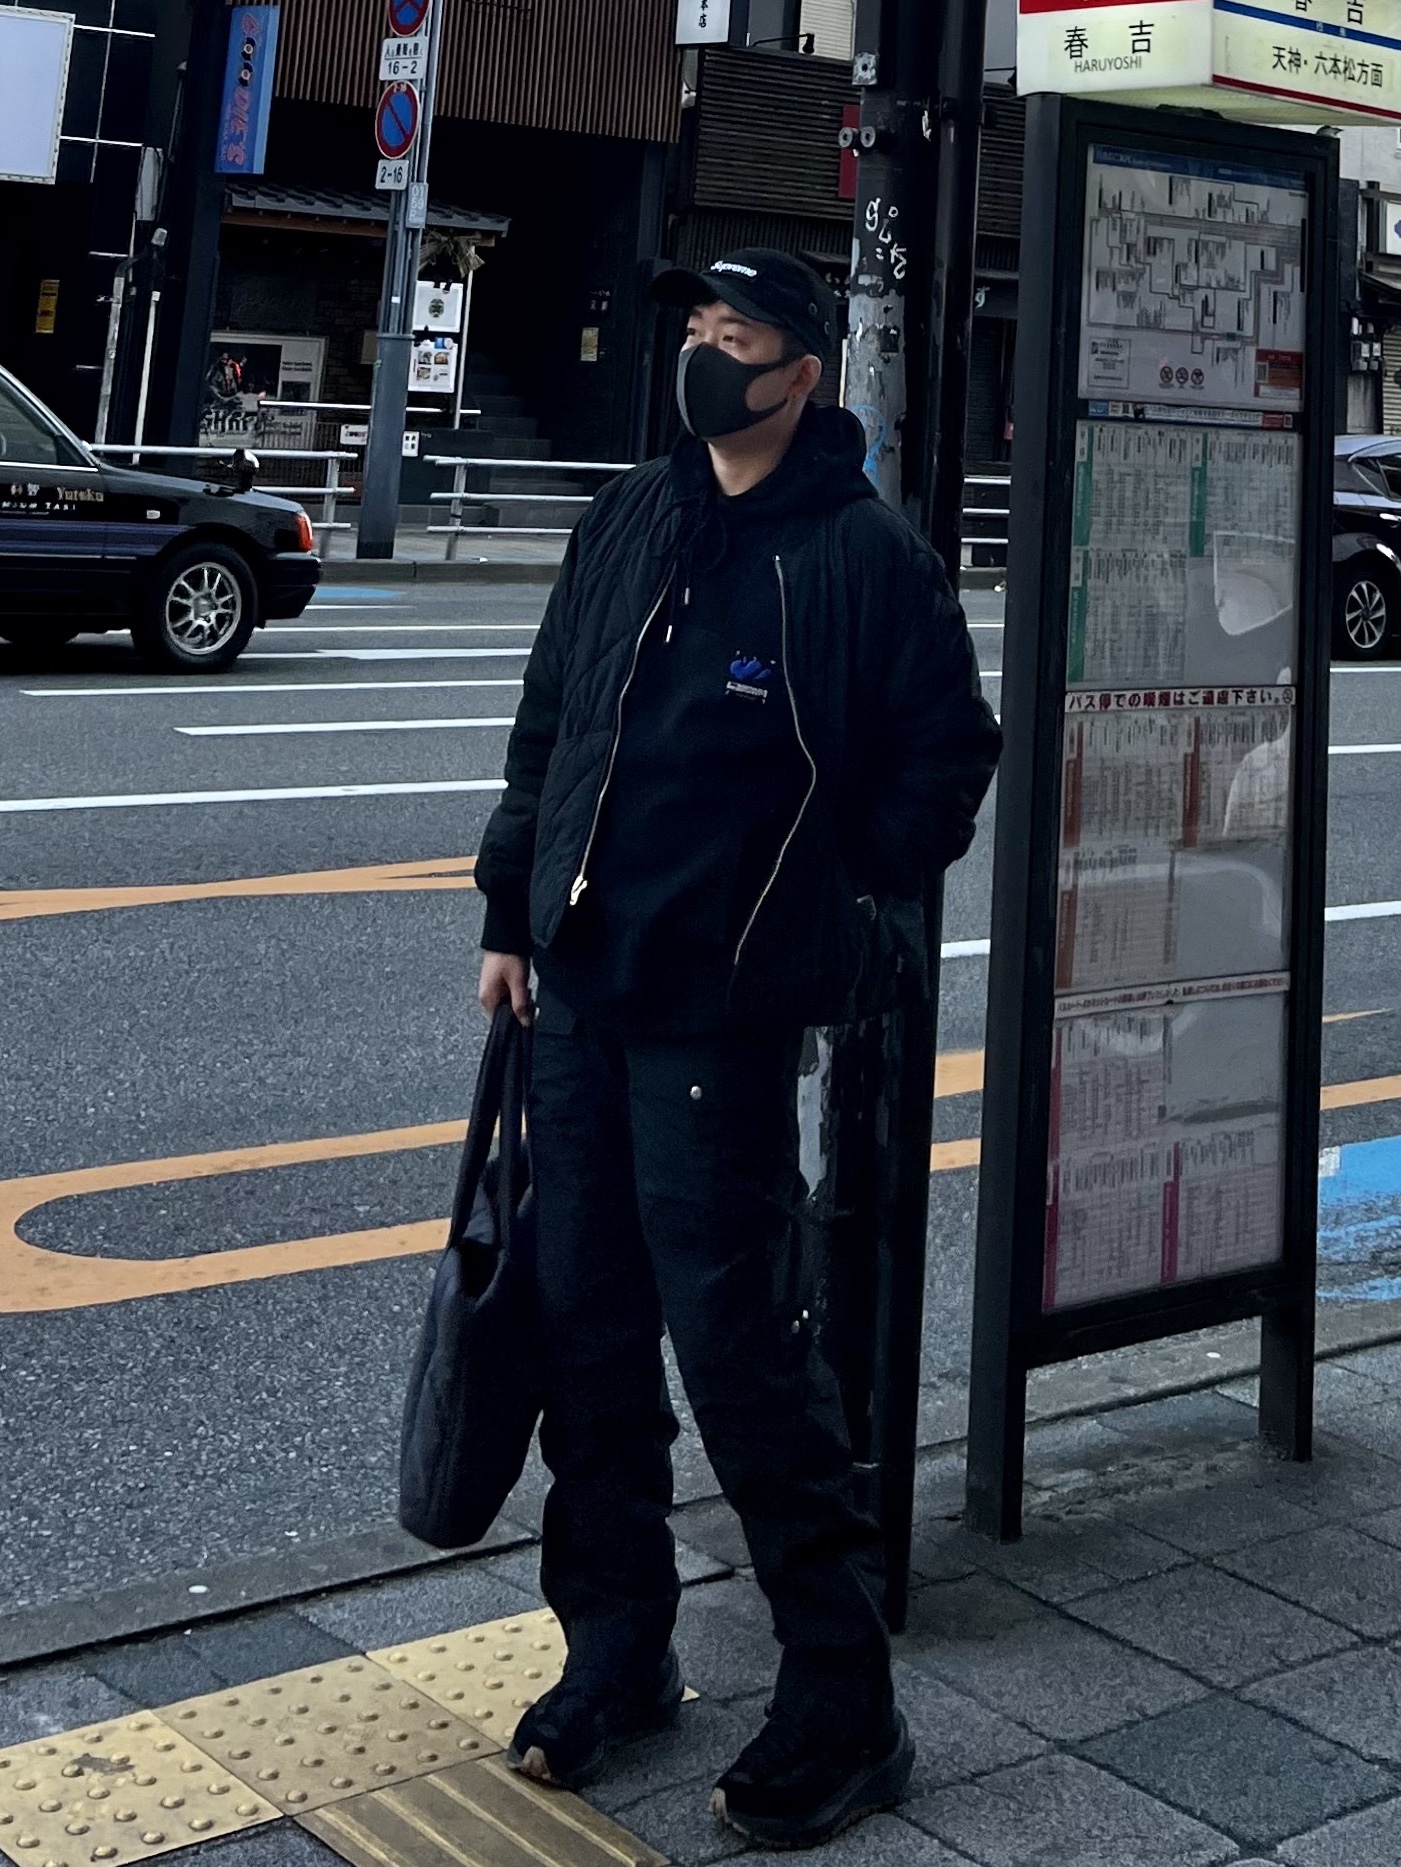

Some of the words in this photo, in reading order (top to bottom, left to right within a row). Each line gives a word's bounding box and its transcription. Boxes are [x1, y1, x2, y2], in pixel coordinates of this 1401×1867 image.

[1064, 20, 1155, 60] 春吉
[387, 60, 418, 75] 16-2
[1074, 56, 1143, 73] HARUYOSHI
[380, 165, 404, 184] 2-16
